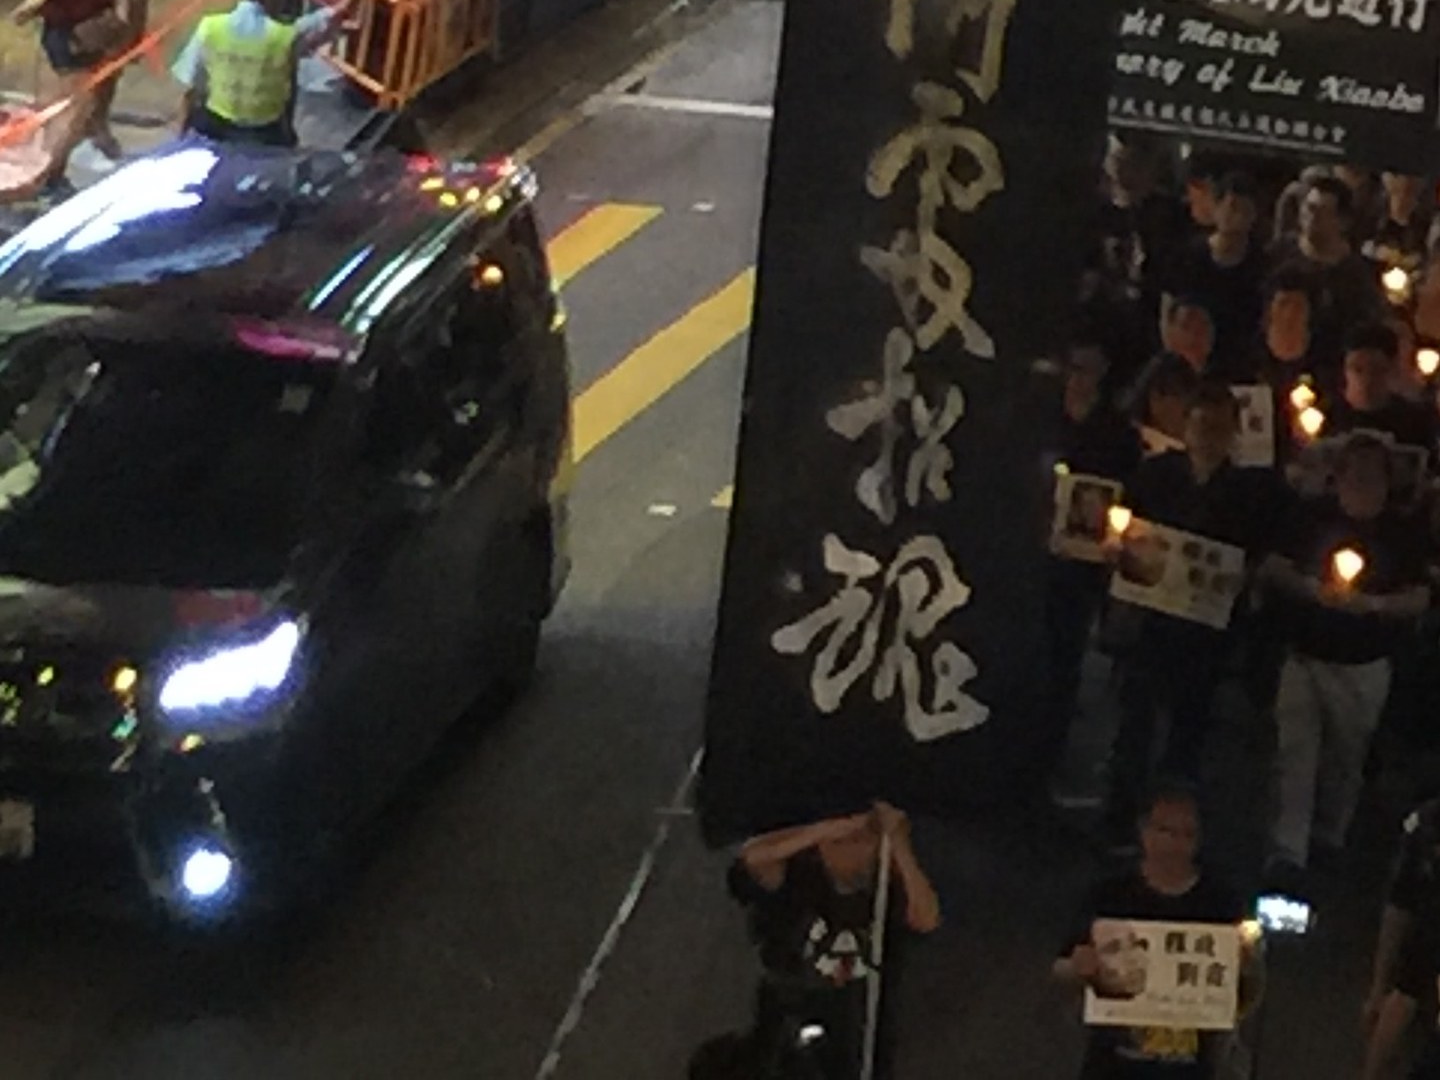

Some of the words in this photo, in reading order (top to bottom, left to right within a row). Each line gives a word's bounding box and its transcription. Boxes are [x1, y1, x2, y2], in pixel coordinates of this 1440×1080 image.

[1178, 17, 1281, 58] March
[1196, 57, 1235, 93] of
[1248, 63, 1304, 96] Liu
[1316, 73, 1425, 114] Xiaobo
